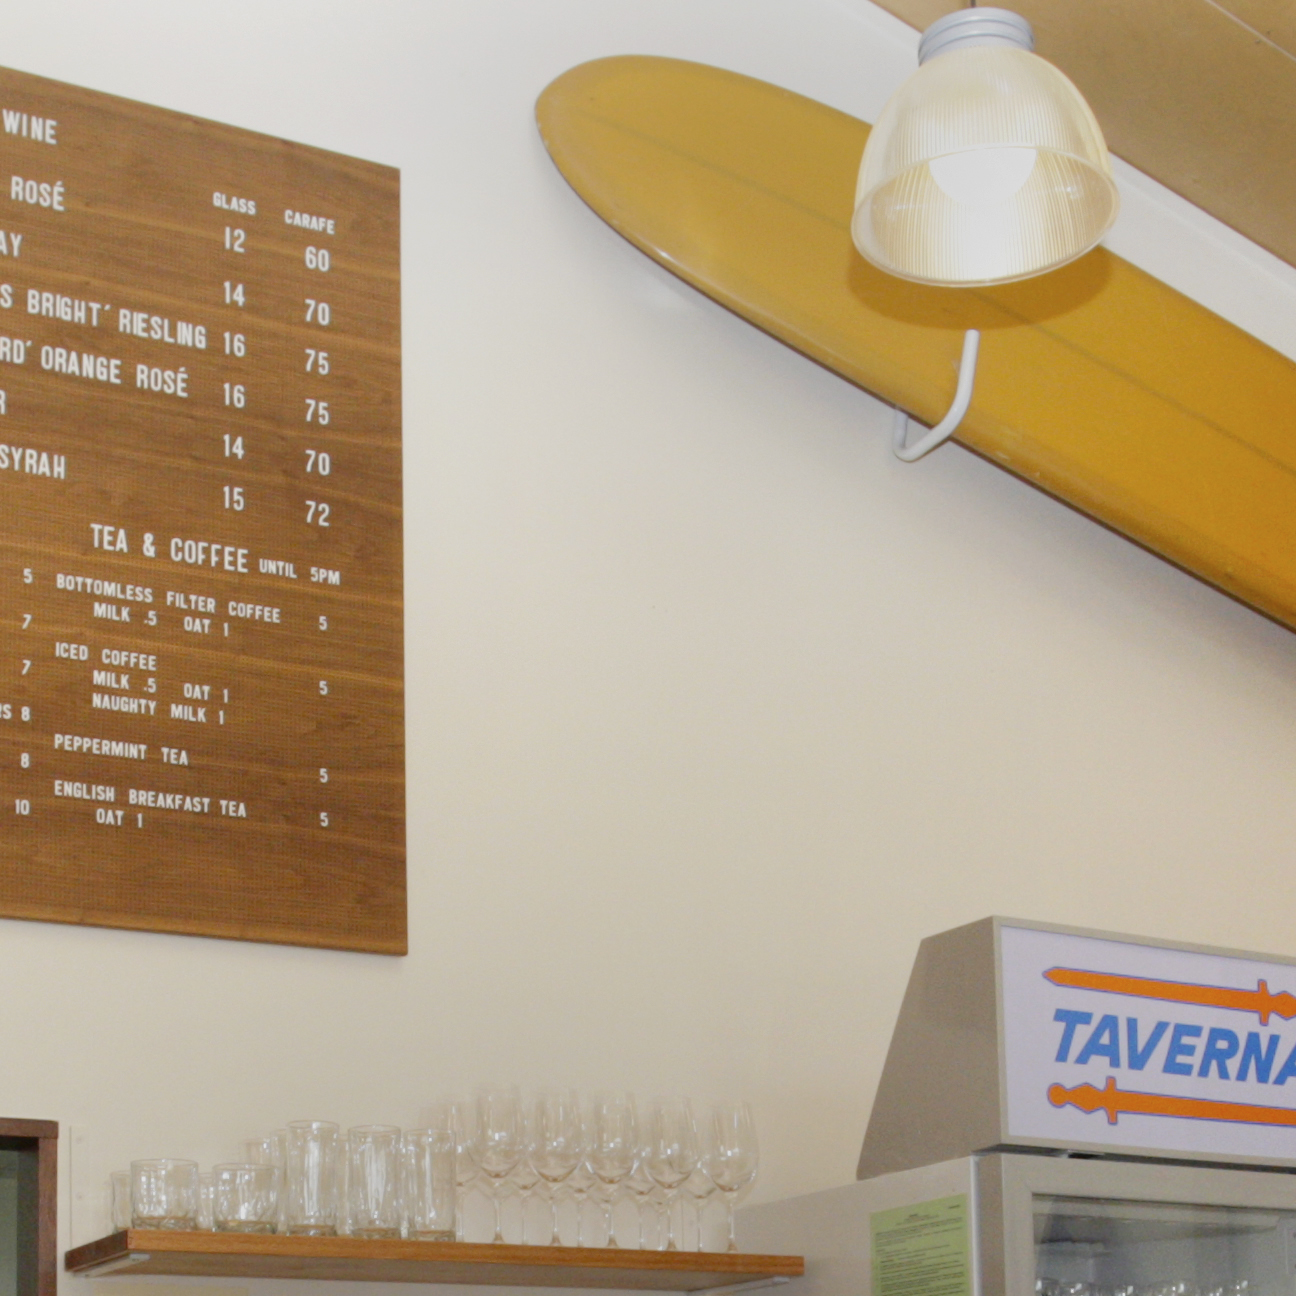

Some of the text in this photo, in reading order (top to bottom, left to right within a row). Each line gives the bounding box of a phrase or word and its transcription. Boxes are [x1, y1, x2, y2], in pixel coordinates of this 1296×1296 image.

[2, 109, 58, 145] WINE
[11, 176, 65, 211] ROSÉ
[119, 308, 207, 349] RIESLING
[41, 345, 122, 384] ORANGE
[136, 364, 188, 398] ROSÉ
[90, 523, 249, 573] TEA & COFFEE
[56, 573, 281, 623] BOTTOMLESS FILTER COFFEE
[54, 733, 188, 766] PEPPERMINT TEA
[54, 780, 247, 818] ENGLISH BREAKFAST TEA
